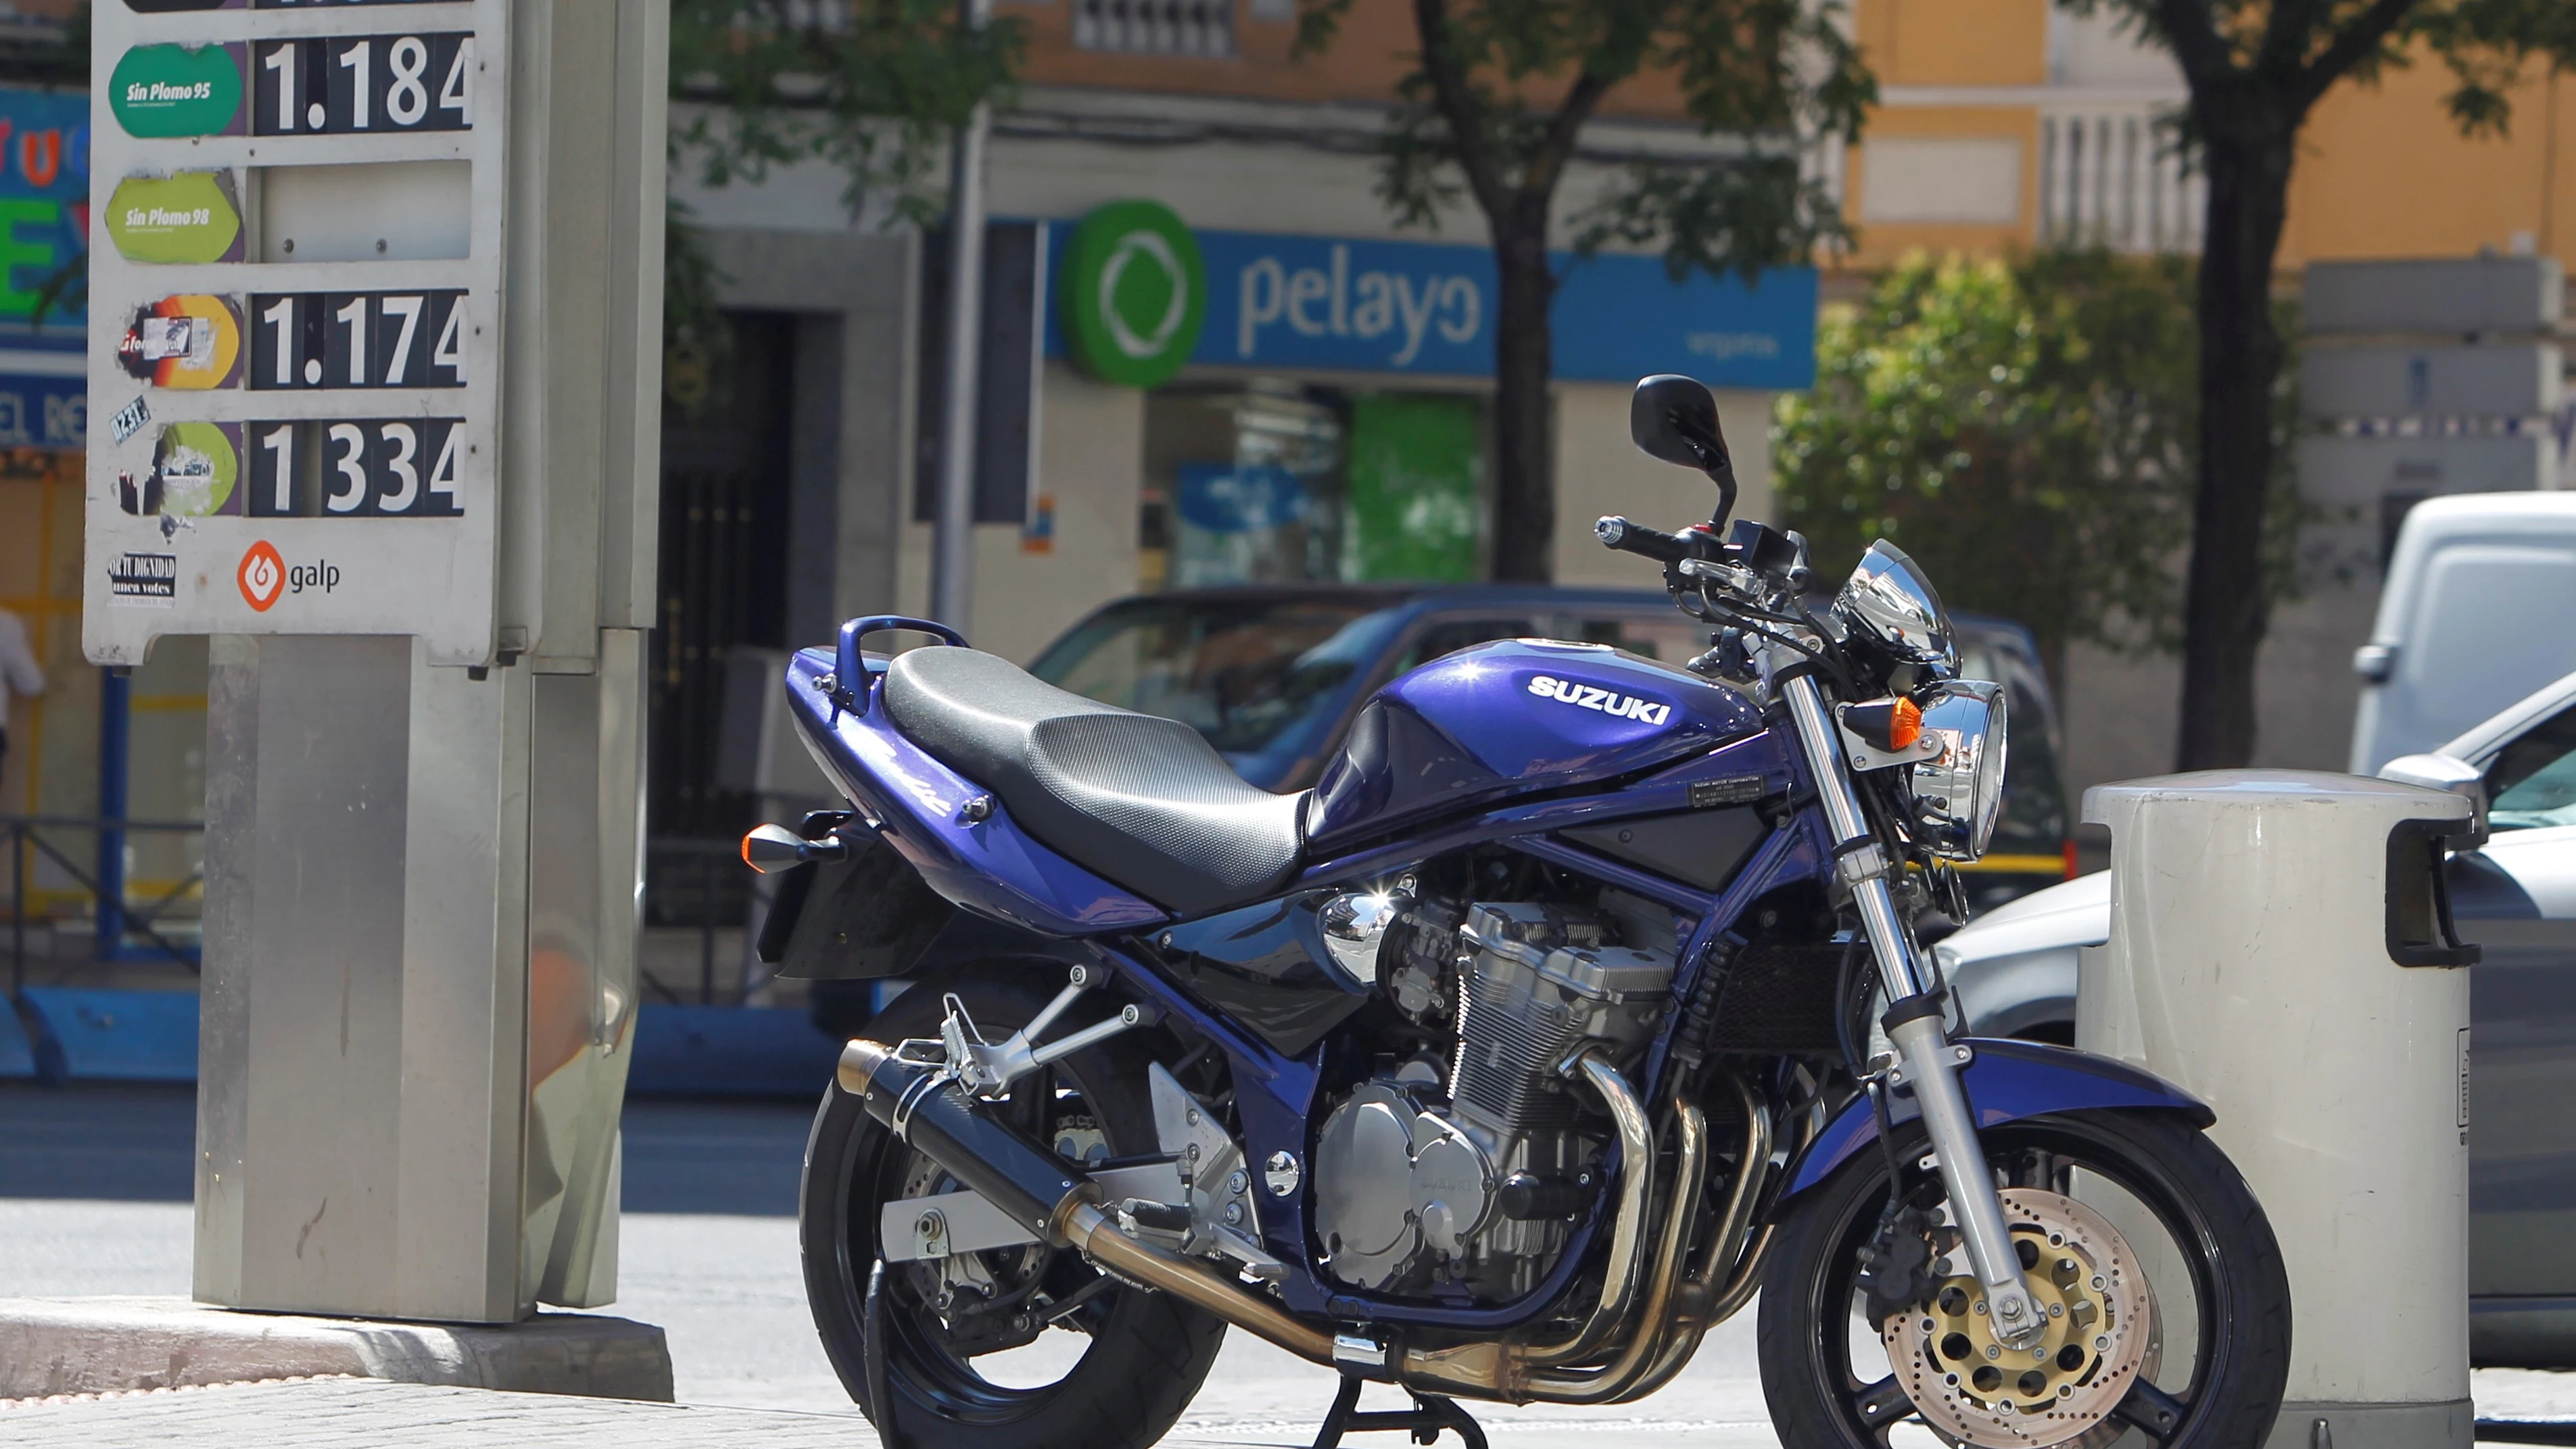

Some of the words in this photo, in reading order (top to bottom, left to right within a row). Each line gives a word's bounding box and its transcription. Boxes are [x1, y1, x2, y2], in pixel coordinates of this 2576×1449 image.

[126, 82, 147, 101] Sin
[149, 82, 192, 100] Plomo
[194, 82, 211, 99] 95
[265, 37, 475, 129] 1.184
[126, 208, 146, 226] Sin
[148, 207, 191, 225] Plomo
[193, 208, 210, 224] 98
[1237, 244, 1481, 366] pelayo
[264, 295, 468, 384] 1.174
[135, 556, 175, 578] DIGNIDAD
[290, 559, 339, 593] galp
[142, 581, 170, 594] votes
[1527, 675, 1671, 726] SUZUKI
